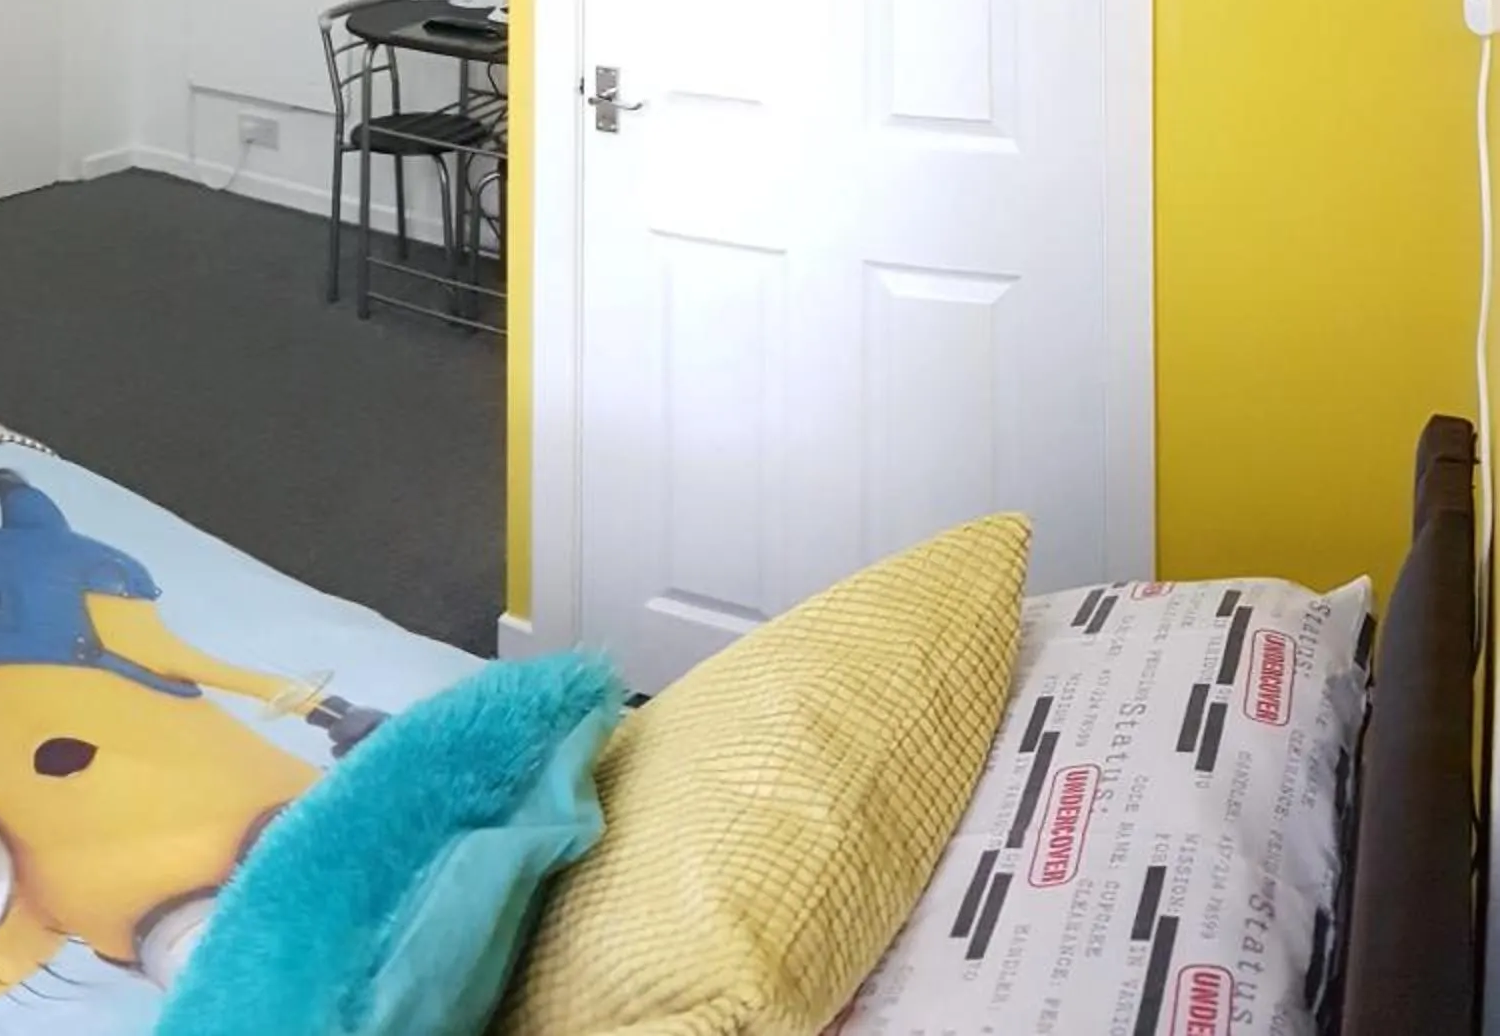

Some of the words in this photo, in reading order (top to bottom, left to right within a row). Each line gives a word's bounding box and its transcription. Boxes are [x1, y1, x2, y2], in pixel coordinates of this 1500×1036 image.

[1258, 635, 1285, 721] UNDERCOVER
[1089, 702, 1145, 815] Status:
[1042, 771, 1088, 884] UNDERCOVER
